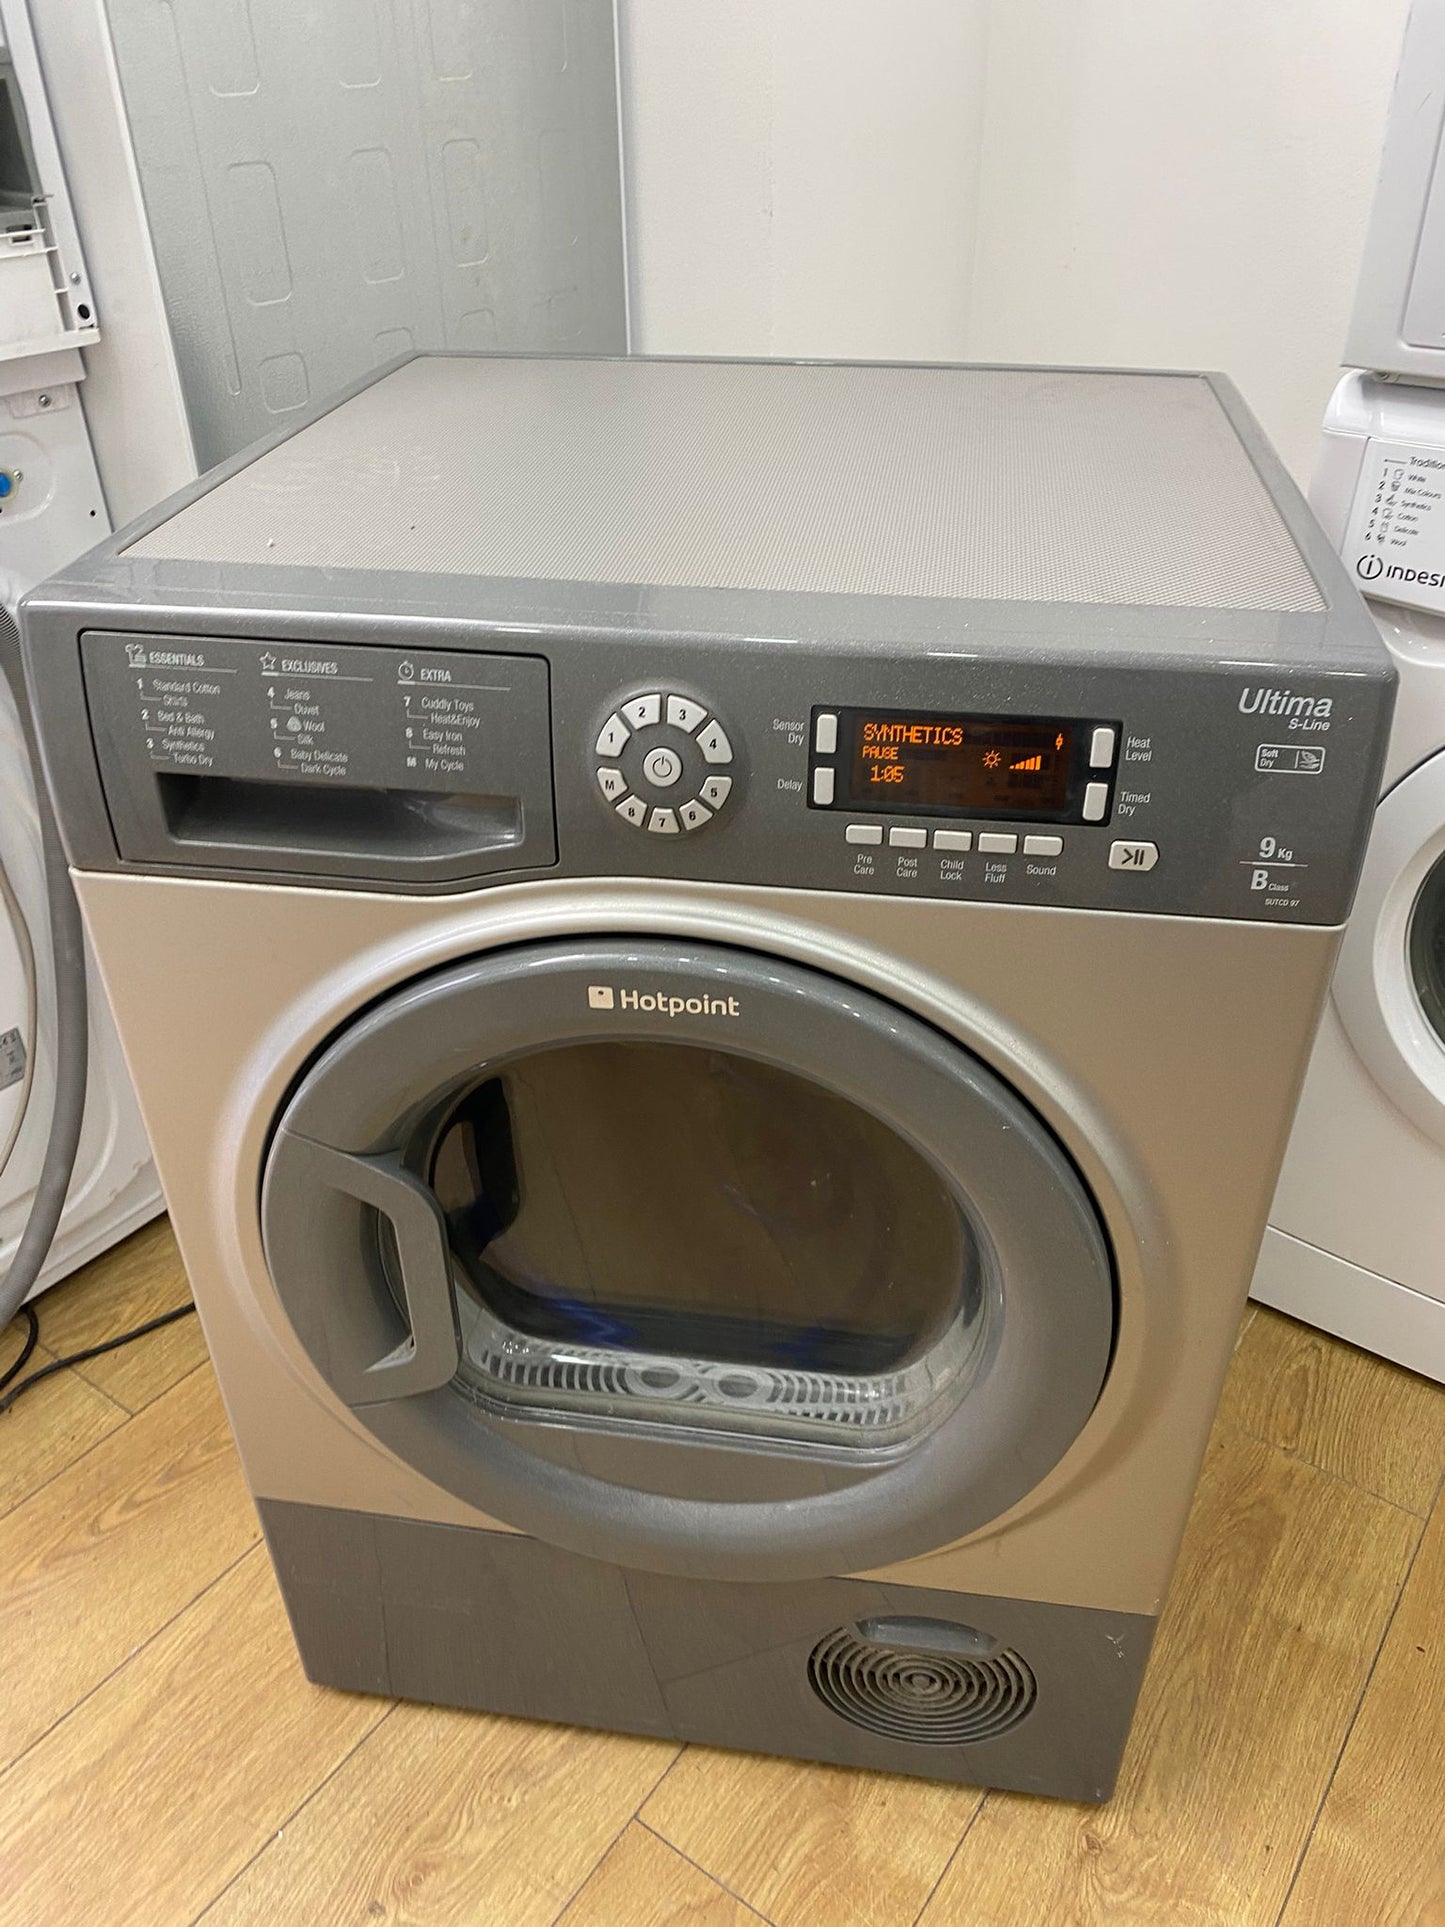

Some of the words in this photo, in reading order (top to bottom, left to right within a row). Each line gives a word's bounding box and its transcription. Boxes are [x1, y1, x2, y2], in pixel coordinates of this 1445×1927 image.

[1379, 480, 1386, 491] 2
[1375, 493, 1383, 504] 3
[1371, 506, 1380, 516] 4
[1368, 518, 1376, 529] 5
[1365, 531, 1372, 541] 6
[149, 651, 205, 667] ESSENTIALS
[281, 659, 339, 675] EXCLUSIVES
[420, 668, 452, 683] EXTRA
[136, 678, 143, 690] 1
[152, 679, 192, 694] Standard
[192, 681, 221, 695] Cotton
[266, 686, 276, 698] 4
[284, 688, 311, 701] Jeans
[294, 703, 320, 716] Duvet
[403, 695, 412, 708] 7
[421, 696, 452, 712] Cuddly
[453, 699, 475, 714] Toys
[1238, 687, 1334, 718] Ultima
[141, 708, 150, 721] 2
[638, 706, 646, 718] 2
[679, 708, 687, 721] 3
[303, 720, 326, 733] Wool
[430, 711, 481, 729] Heat&Enjoy
[772, 718, 806, 732] Sensor
[1287, 717, 1332, 732] S-Line
[186, 726, 215, 741] Allergy
[405, 727, 414, 740] 8
[422, 728, 444, 743] Easy
[444, 730, 463, 742] Iron
[608, 732, 615, 743] 1
[787, 731, 805, 746] Dry
[863, 722, 964, 746] SYNTHETICS
[146, 738, 155, 750] 3
[161, 738, 206, 753] Synthetics
[709, 738, 718, 750] 4
[1126, 735, 1152, 749] Heat
[290, 748, 312, 762] Baby
[313, 750, 349, 764] Delicate
[432, 743, 467, 757] Refresh
[861, 744, 900, 761] PAUSE
[1125, 748, 1153, 763] Level
[1260, 747, 1280, 759] Soft
[172, 752, 198, 766] Turbo
[198, 754, 215, 768] Dry
[424, 758, 440, 772] My
[440, 759, 465, 773] Cycle
[1258, 757, 1276, 769] Dry
[300, 763, 322, 775] Dark
[322, 764, 347, 777] Cycle
[869, 764, 906, 784] 1:05
[605, 780, 615, 792] M
[777, 777, 803, 793] Delay
[710, 787, 719, 799] 5
[1120, 790, 1152, 804] Timed
[628, 806, 636, 818] 8
[688, 811, 697, 823] 6
[1117, 803, 1136, 817] Dry
[658, 817, 667, 829] 7
[1258, 836, 1277, 859] 9
[1277, 847, 1294, 862] Kg
[856, 853, 874, 865] Pre
[897, 855, 919, 868] Post
[939, 859, 965, 871] Child
[853, 864, 876, 876] Care
[895, 867, 919, 878] Care
[984, 861, 1009, 874] Less
[1025, 863, 1058, 877] Sound
[939, 870, 963, 881] Lock
[983, 873, 1007, 884] Fluff
[1250, 869, 1269, 891] B
[1268, 883, 1290, 893] Class
[1290, 898, 1302, 908] 97
[620, 988, 741, 1018] Hotpoint
